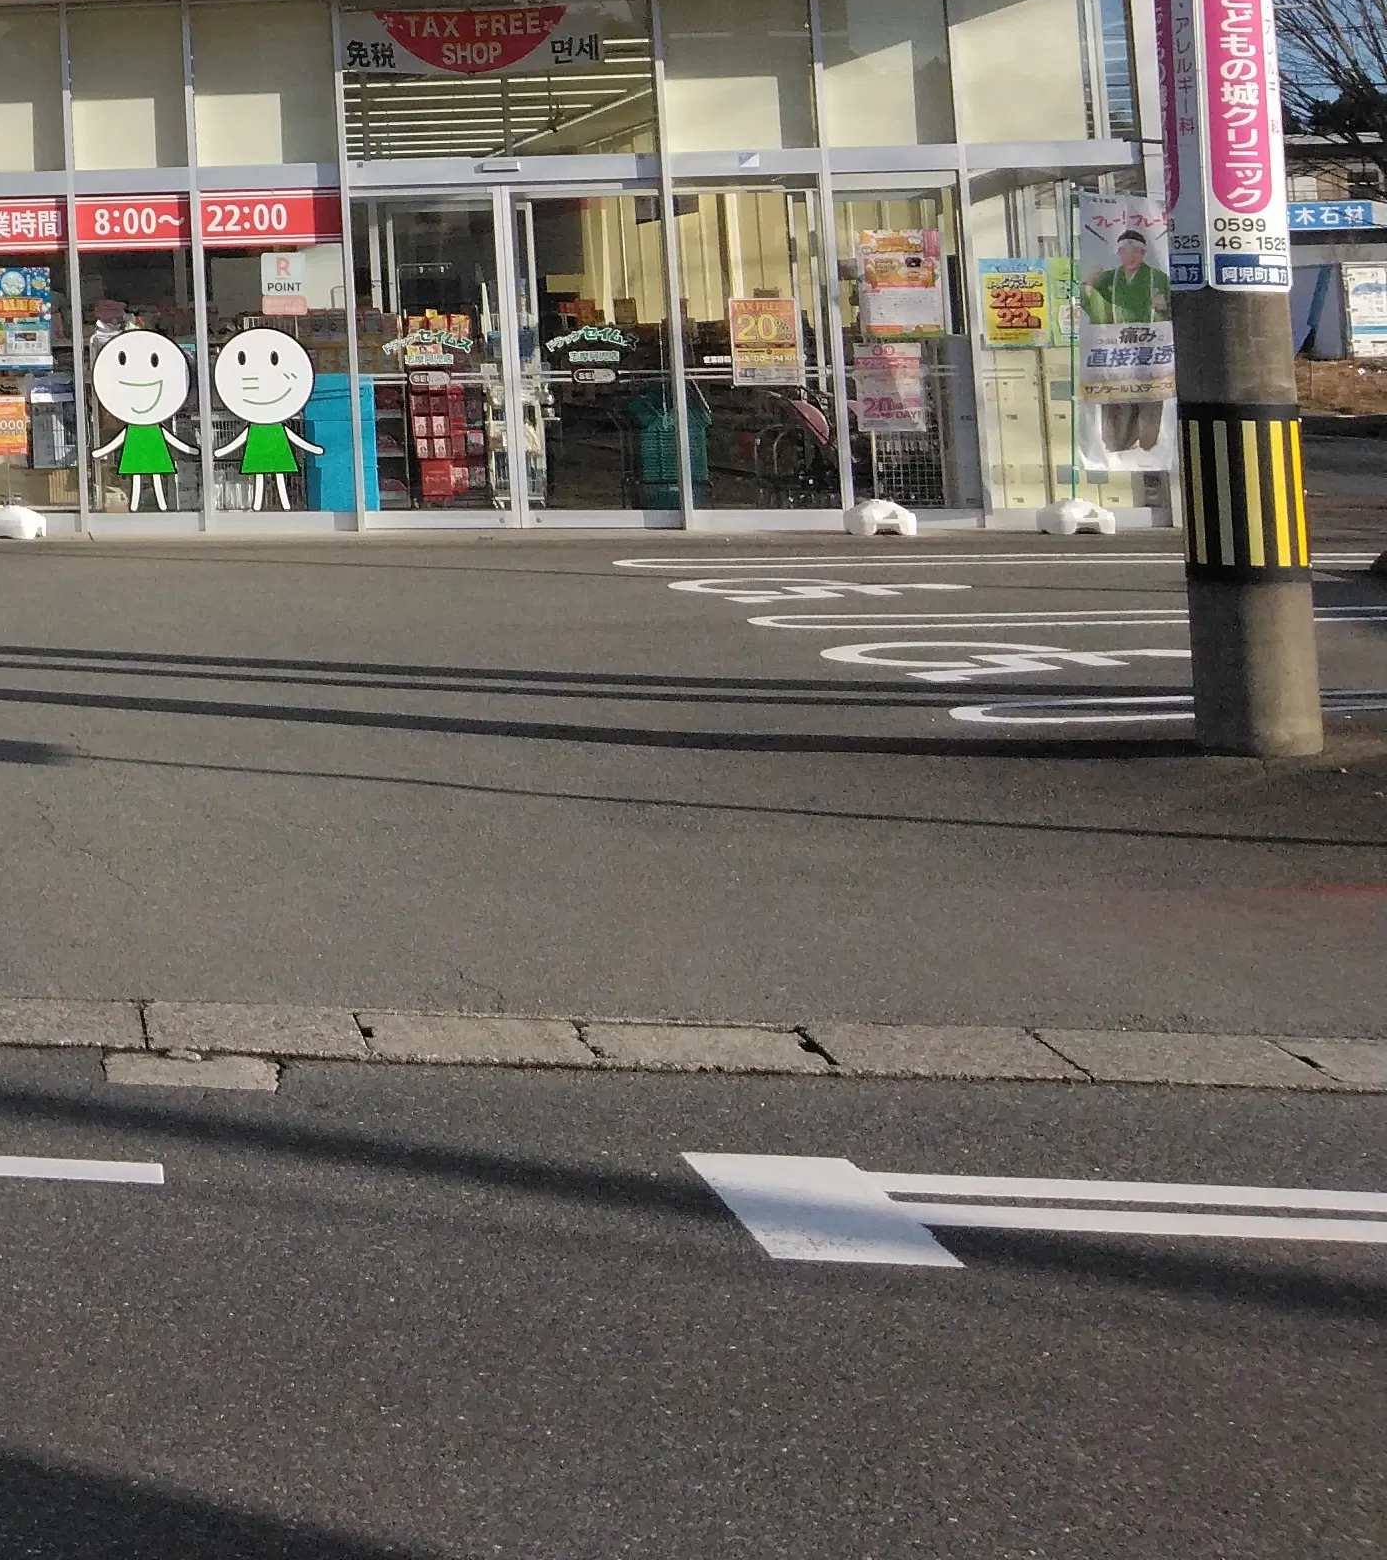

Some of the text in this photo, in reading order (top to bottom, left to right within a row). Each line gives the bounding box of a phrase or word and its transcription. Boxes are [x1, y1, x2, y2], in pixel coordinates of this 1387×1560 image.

[404, 10, 542, 38] TAX FREE
[346, 40, 396, 69] 免税
[442, 41, 502, 65] SHOP
[551, 33, 601, 64] 면세
[206, 202, 287, 232] 22:00
[1214, 217, 1266, 233] 0599
[1287, 205, 1364, 227] 木石材
[267, 282, 302, 292] POINT
